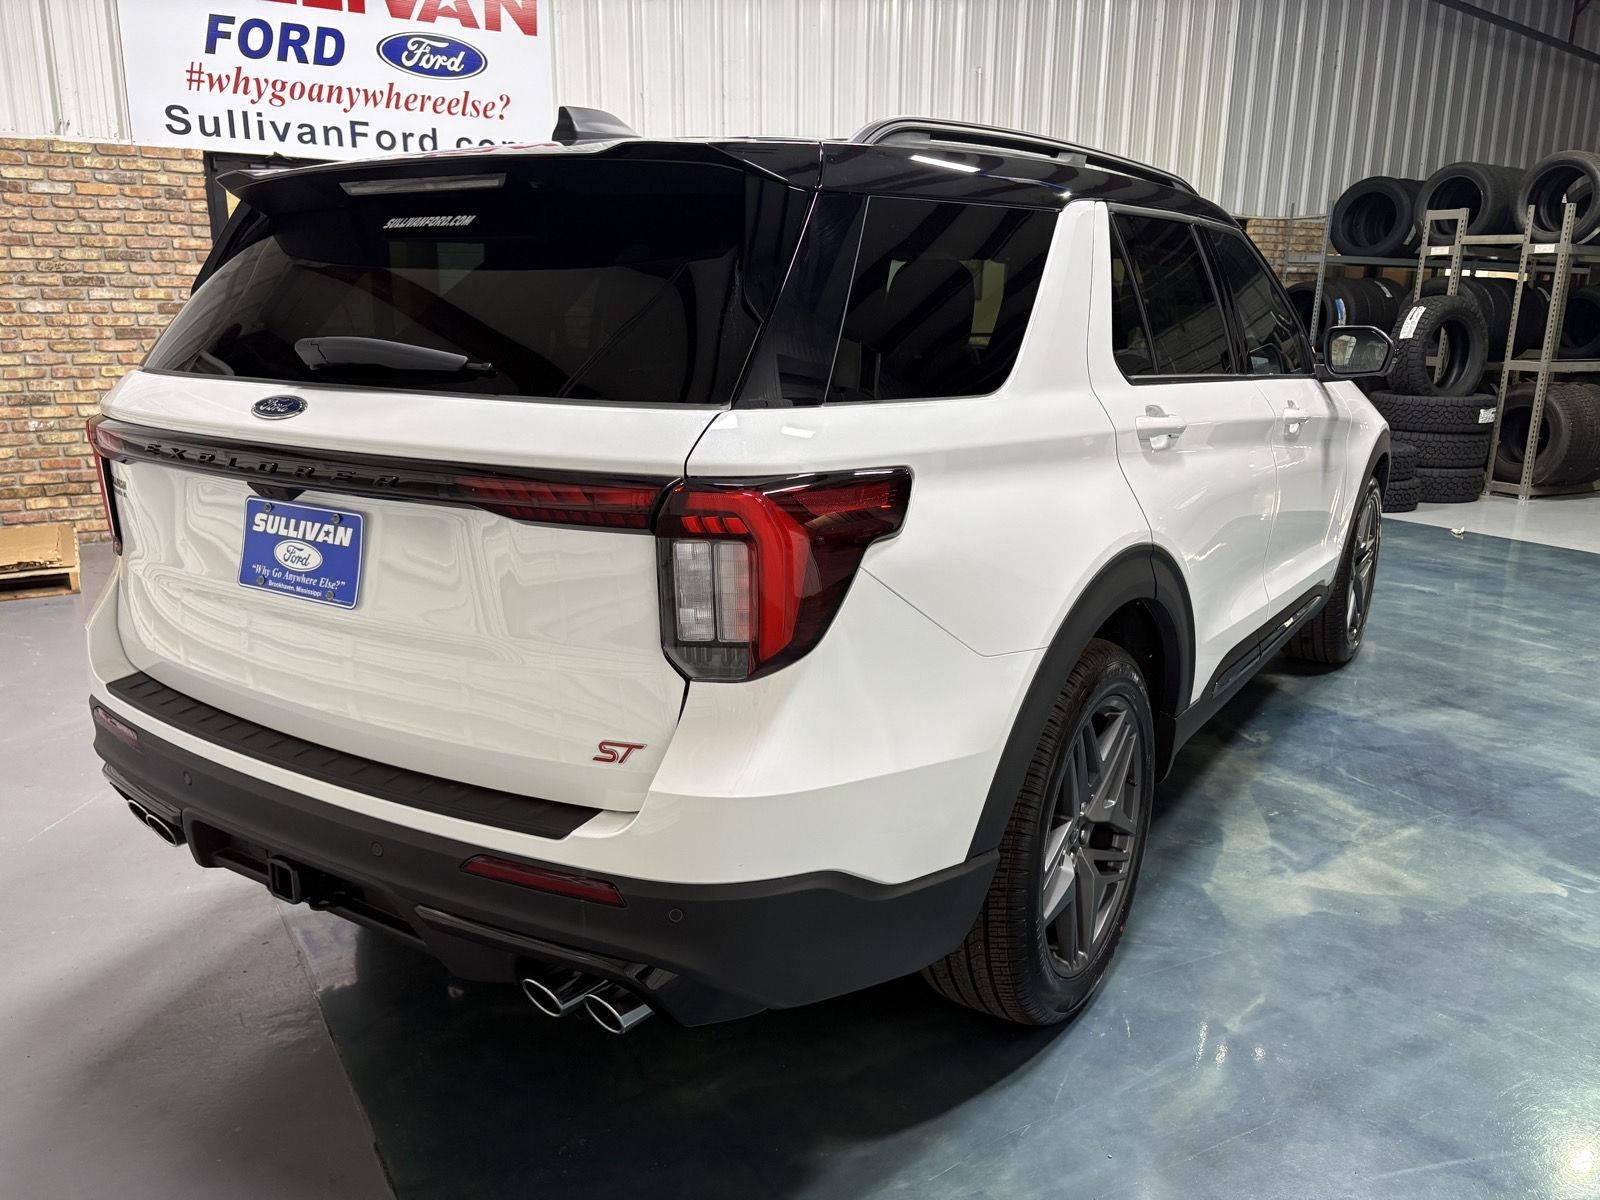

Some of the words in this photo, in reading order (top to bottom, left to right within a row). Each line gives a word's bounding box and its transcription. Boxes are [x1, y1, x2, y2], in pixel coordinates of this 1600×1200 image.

[204, 13, 346, 67] FORD
[401, 37, 466, 72] Ford
[185, 61, 511, 121] #whygoanywhereelse?
[382, 214, 477, 230] SULLIVANFORD.COM
[144, 442, 400, 488] EXPLORER
[252, 512, 354, 547] SULLIVAN
[282, 544, 312, 567] Ford
[272, 567, 282, 579] Go
[282, 570, 318, 586] Anywhere
[296, 585, 322, 598] Mississippi
[592, 739, 648, 764] ST
